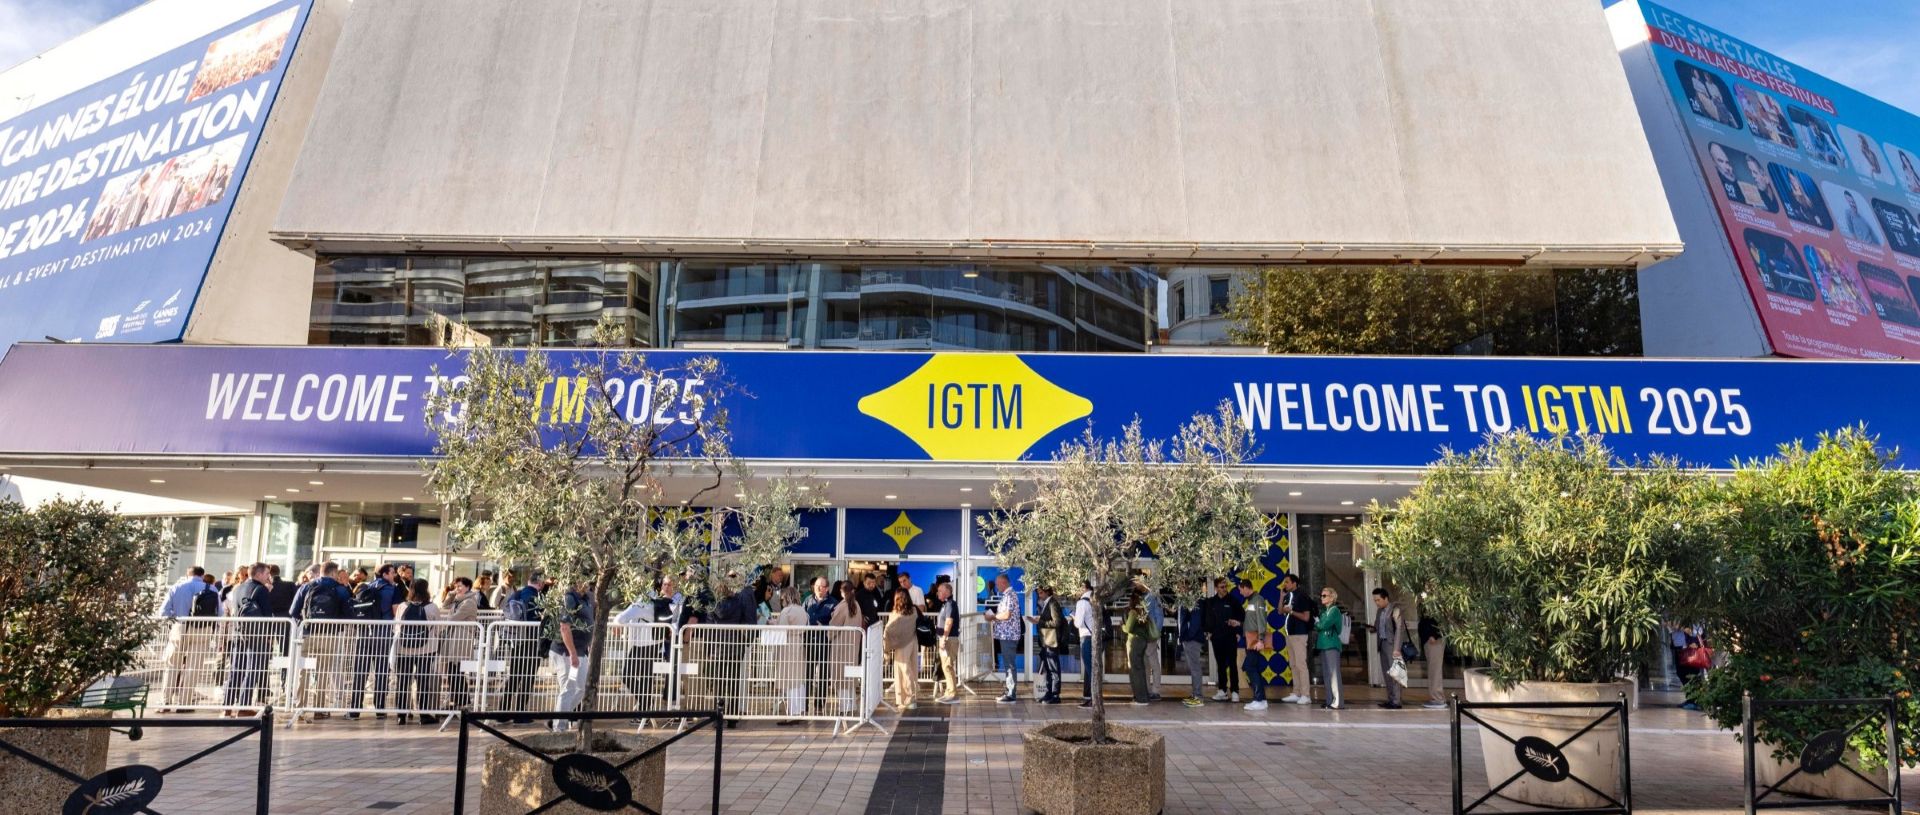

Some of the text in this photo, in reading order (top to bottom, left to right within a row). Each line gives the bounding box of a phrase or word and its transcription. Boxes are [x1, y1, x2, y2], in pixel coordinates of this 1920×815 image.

[1651, 7, 1797, 85] LES SPECTACLES
[1660, 30, 1835, 115] DU PALAIS DES FESTIVALS
[2, 94, 118, 167] CANNES
[108, 60, 199, 127] ÉLUE
[40, 80, 270, 198] DESTINATION
[11, 197, 90, 257] 2024
[25, 257, 70, 282] EVENT
[70, 230, 170, 270] DESTINATION
[172, 216, 213, 242] 2024
[205, 372, 412, 423] WELCOME
[487, 376, 589, 424] TM
[600, 377, 705, 425] 2025
[927, 382, 1023, 430] IGTM
[1233, 382, 1752, 436] WELCOME TO IGTM 2025
[894, 526, 912, 536] IGTM
